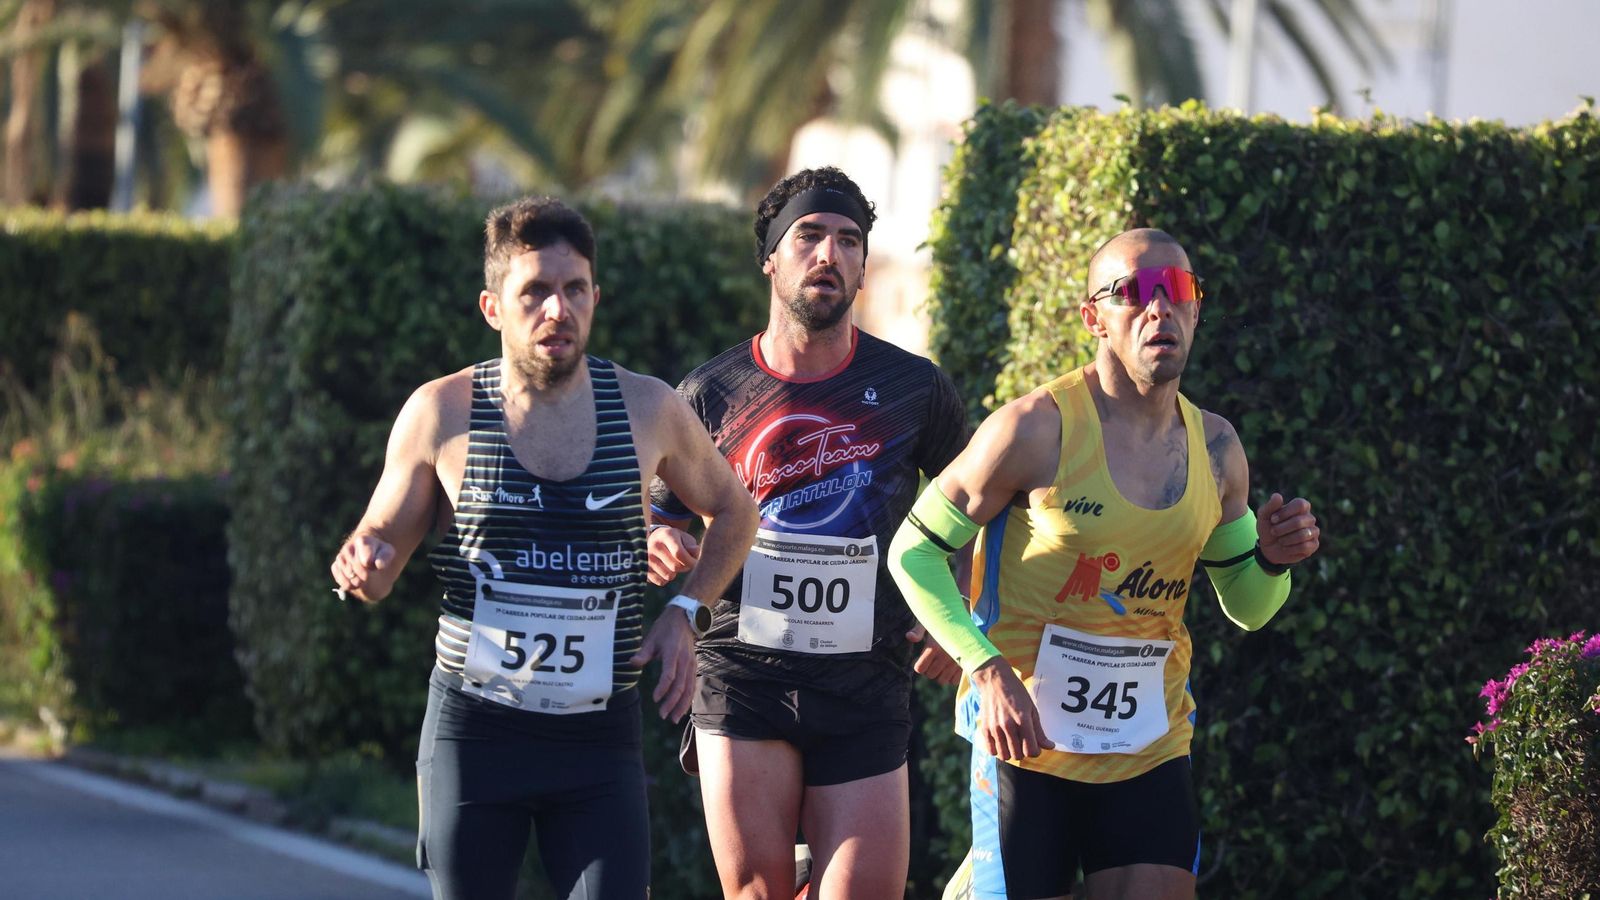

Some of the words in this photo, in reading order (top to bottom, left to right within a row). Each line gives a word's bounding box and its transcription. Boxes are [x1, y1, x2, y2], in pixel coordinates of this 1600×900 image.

[469, 485, 494, 502] Run
[494, 486, 525, 503] More
[759, 470, 873, 518] TRIATHLON
[515, 543, 633, 571] abelenda
[770, 556, 795, 564] CARRERA
[796, 558, 821, 566] POPULAR
[571, 574, 632, 585] asesores
[771, 573, 850, 613] 500
[530, 612, 557, 620] POPULAR
[501, 630, 585, 674] 525
[1067, 655, 1096, 666] CARRERA
[1061, 676, 1138, 720] 345
